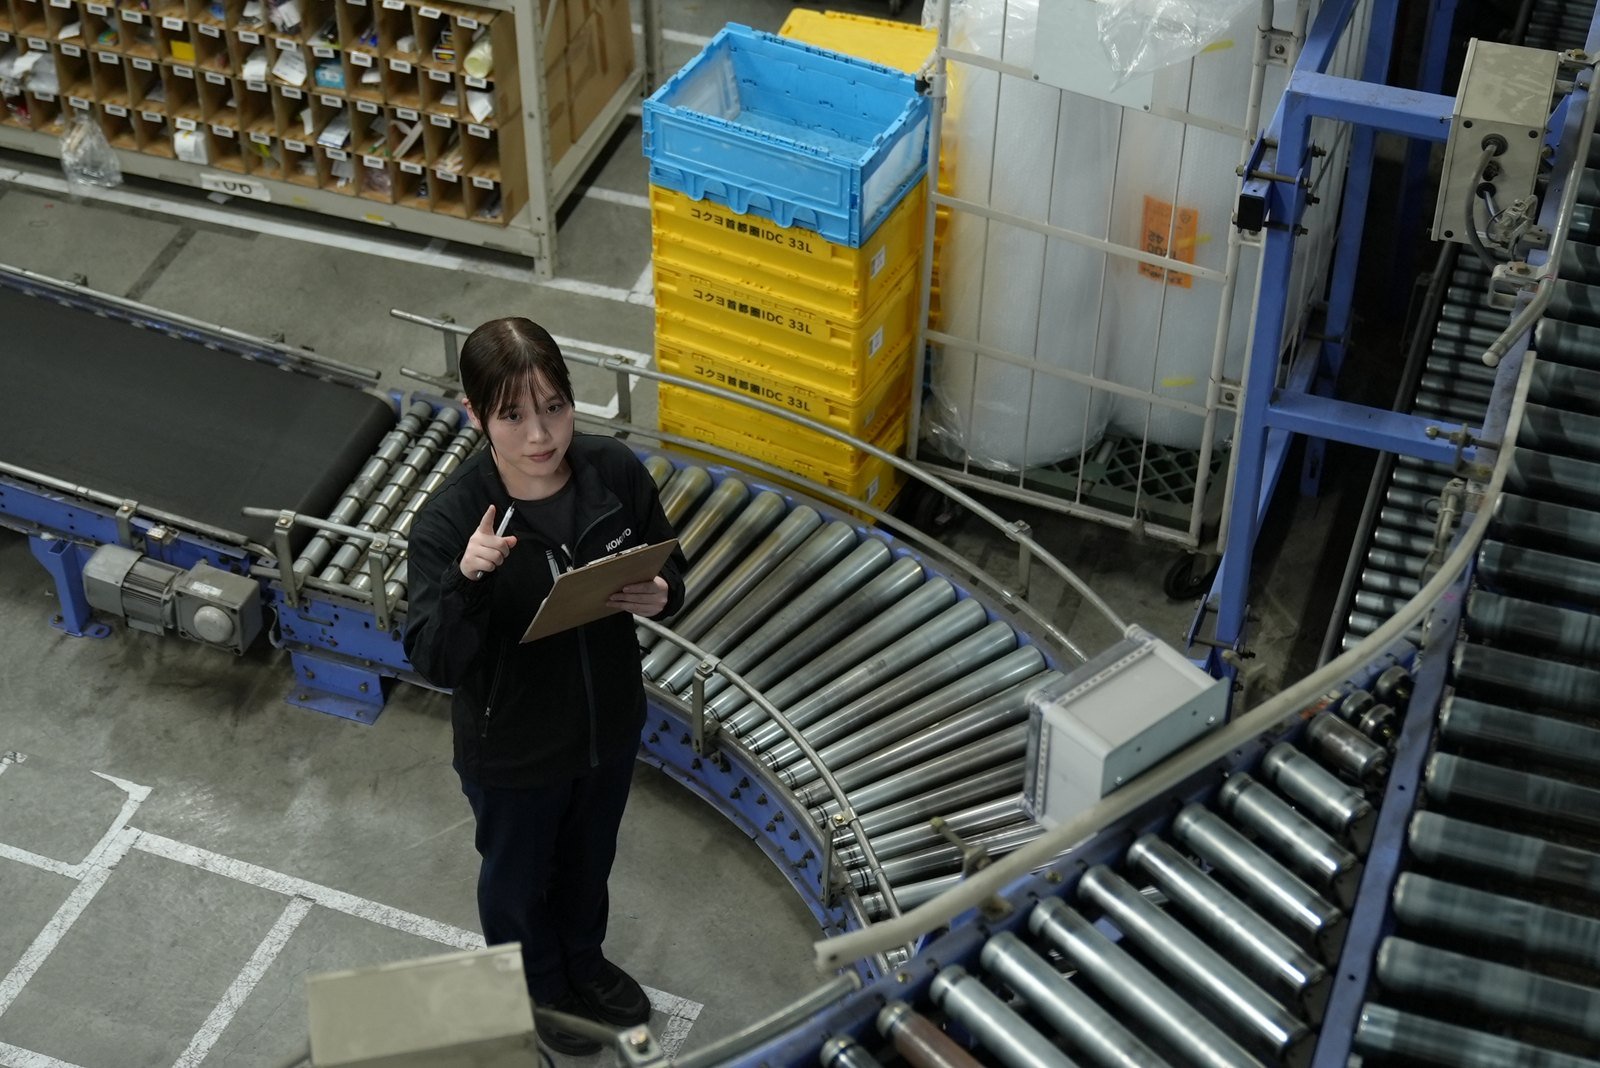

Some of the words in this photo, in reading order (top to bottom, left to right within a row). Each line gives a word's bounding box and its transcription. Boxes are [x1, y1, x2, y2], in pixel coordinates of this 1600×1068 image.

[691, 208, 783, 244] コクヨ首都圏IDC
[788, 237, 813, 254] 33L
[693, 289, 784, 325] コクヨ首都圏IDC
[788, 319, 812, 335] 33L
[694, 365, 783, 402] コクヨ首都圏IDC
[787, 396, 812, 412] 33L
